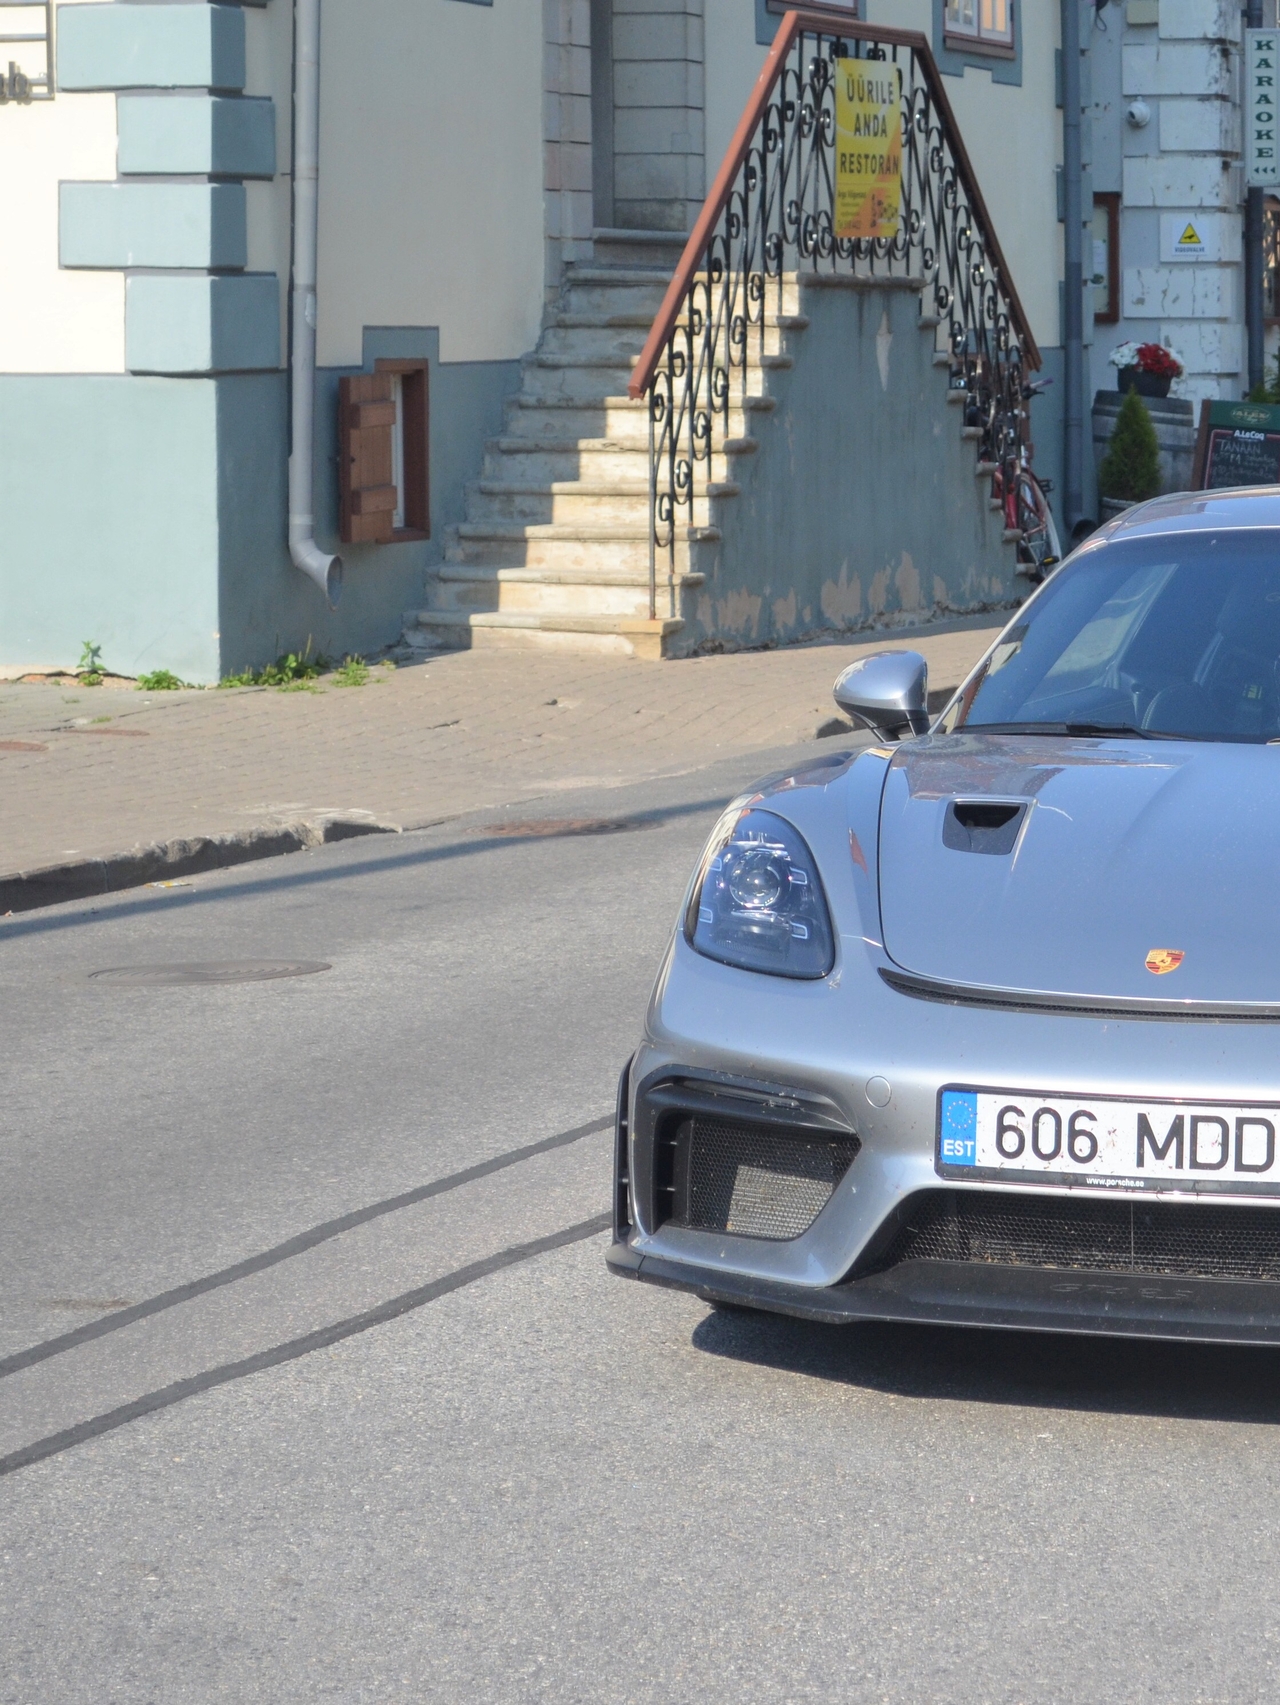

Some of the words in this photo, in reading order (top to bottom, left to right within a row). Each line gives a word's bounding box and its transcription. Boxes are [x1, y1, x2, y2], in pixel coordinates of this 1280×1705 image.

[846, 73, 895, 105] ÜÜRILE
[1254, 39, 1275, 158] KARAOKE
[853, 113, 888, 138] ANDA
[840, 152, 900, 175] RESTORAN
[943, 1139, 975, 1157] EST
[995, 1105, 1098, 1164] 606
[1136, 1112, 1276, 1173] MDD
[1085, 1177, 1145, 1188] www.porsche.ee
